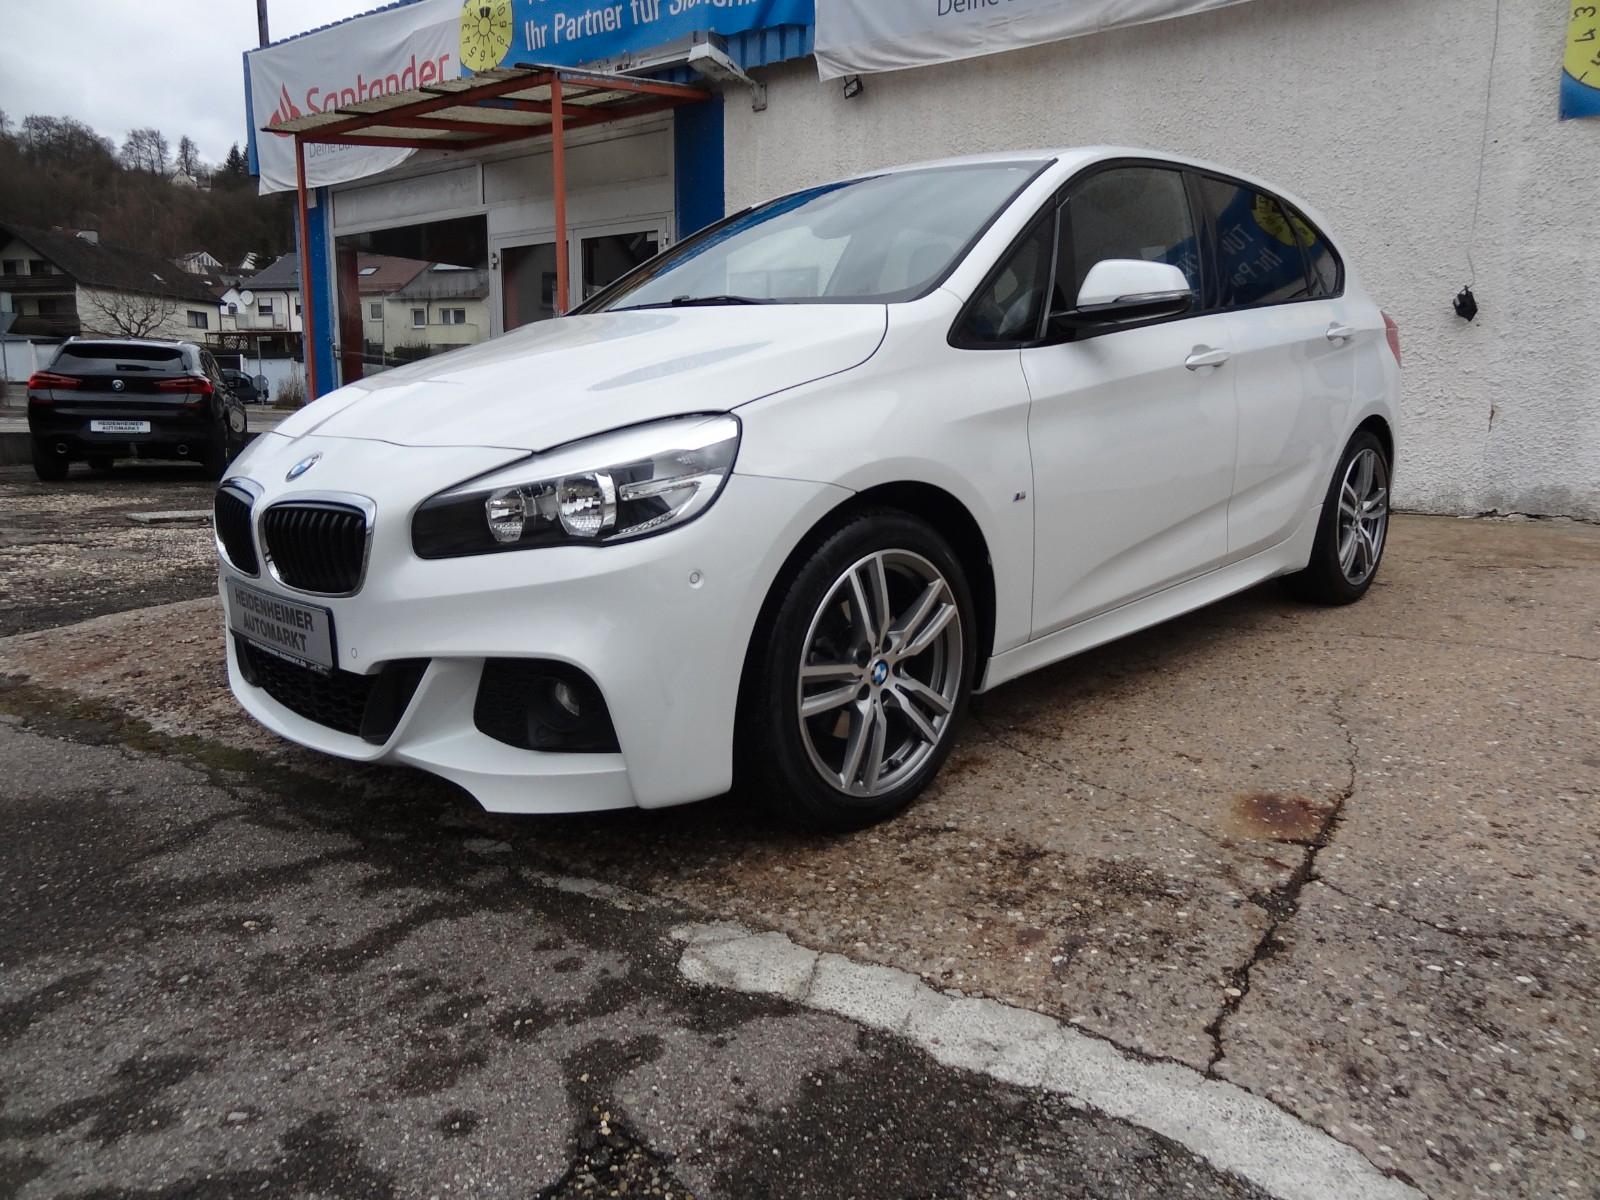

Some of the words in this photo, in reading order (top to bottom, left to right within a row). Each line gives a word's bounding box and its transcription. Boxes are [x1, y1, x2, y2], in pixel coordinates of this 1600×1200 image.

[525, 20, 547, 51] Ihr
[554, 2, 623, 44] Partner
[306, 54, 450, 114] Santander
[235, 587, 314, 631] HEIDENHEIMER
[243, 612, 307, 652] AUTOMARKT
